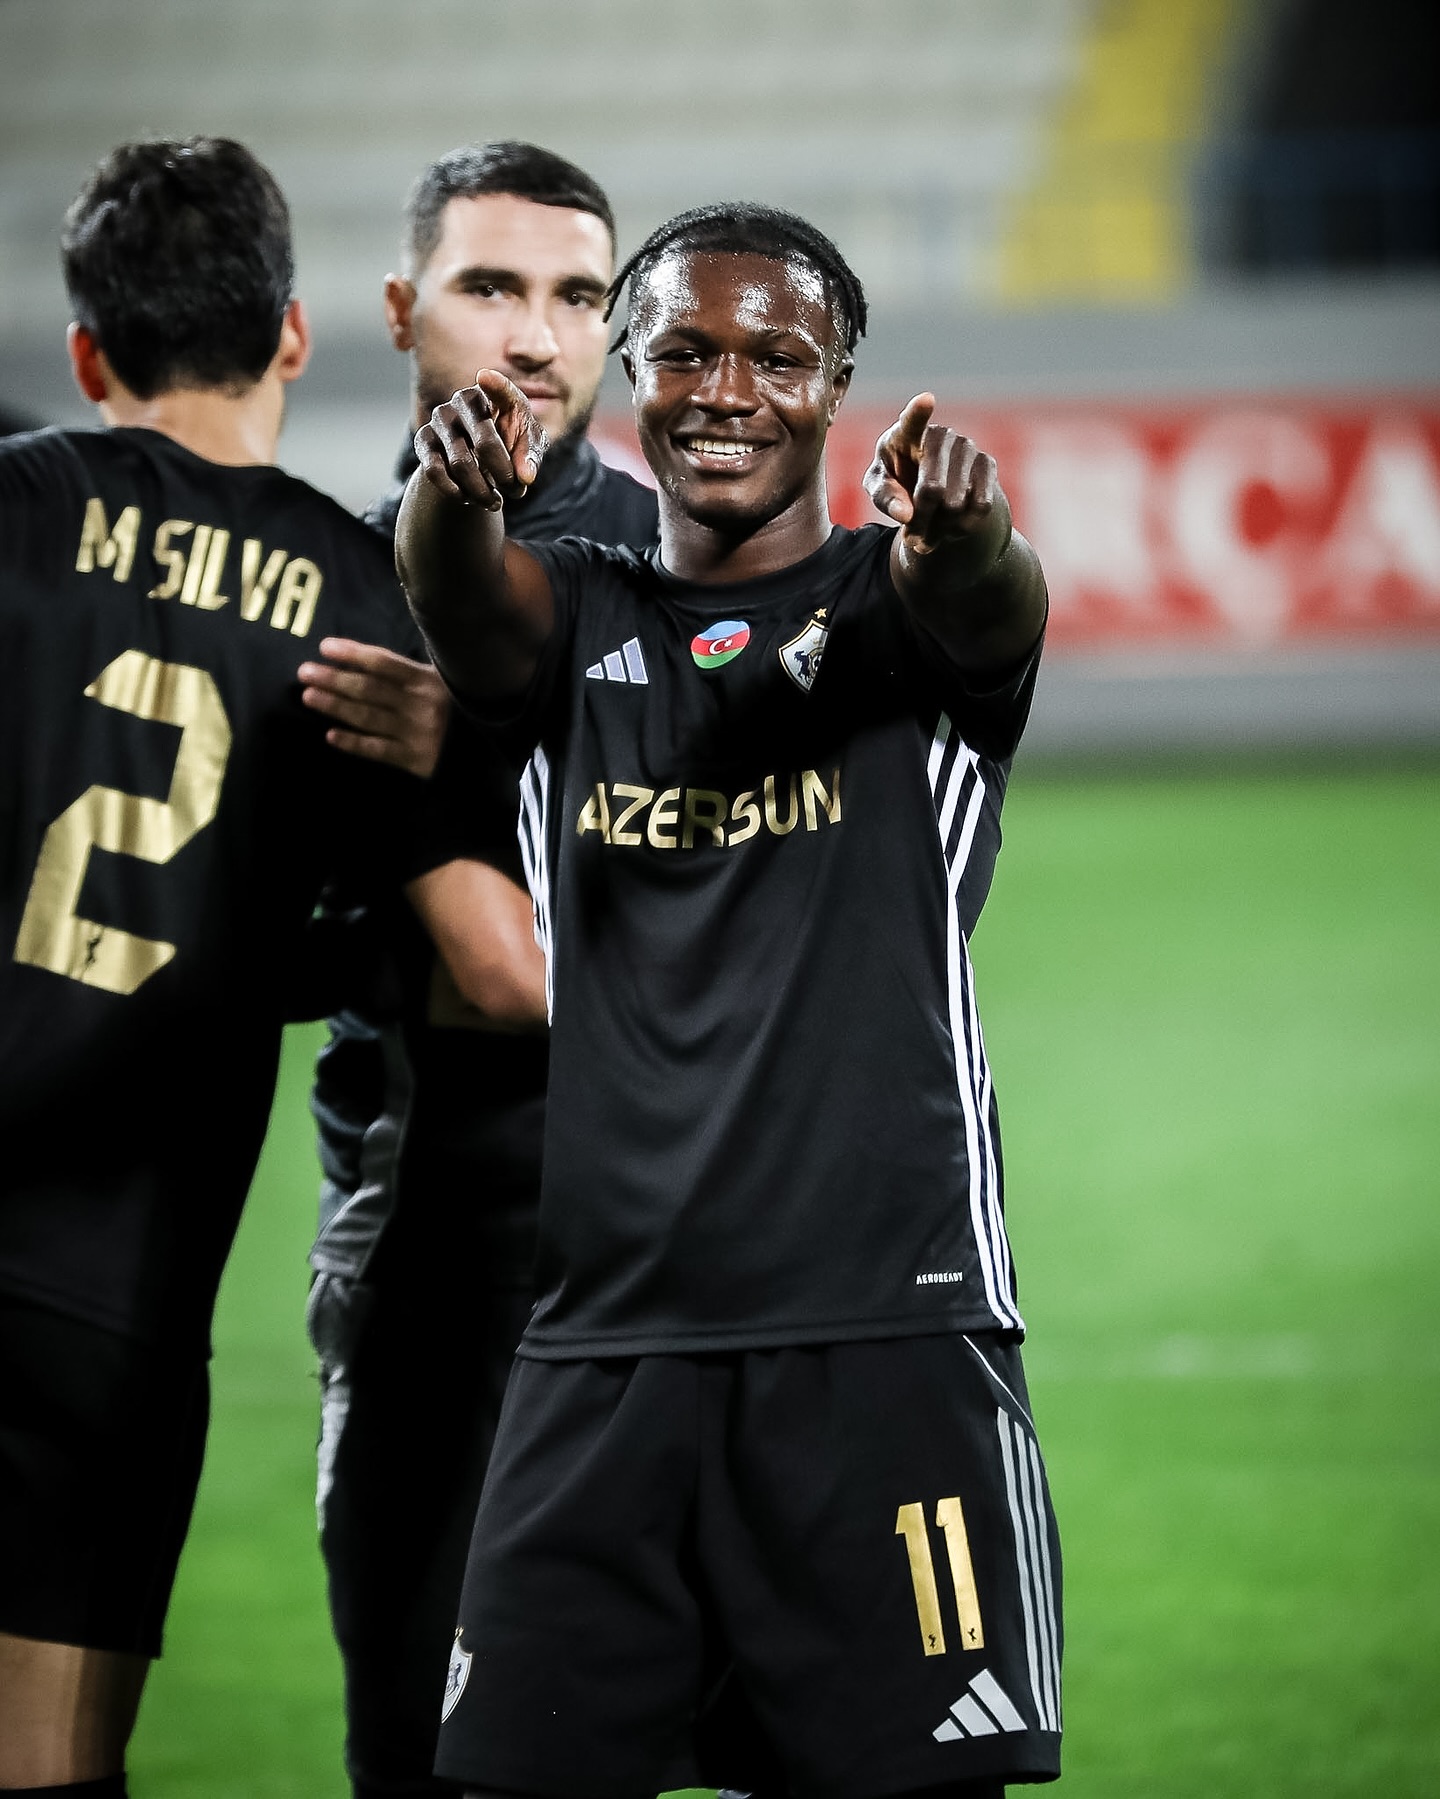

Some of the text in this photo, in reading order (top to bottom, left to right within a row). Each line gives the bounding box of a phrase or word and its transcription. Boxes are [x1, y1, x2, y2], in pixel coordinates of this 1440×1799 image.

[76, 498, 323, 637] M SILVA
[12, 649, 233, 995] 2
[576, 767, 842, 849] AZERSUN
[916, 1271, 963, 1285] AEROREADY
[895, 1497, 984, 1656] 11
